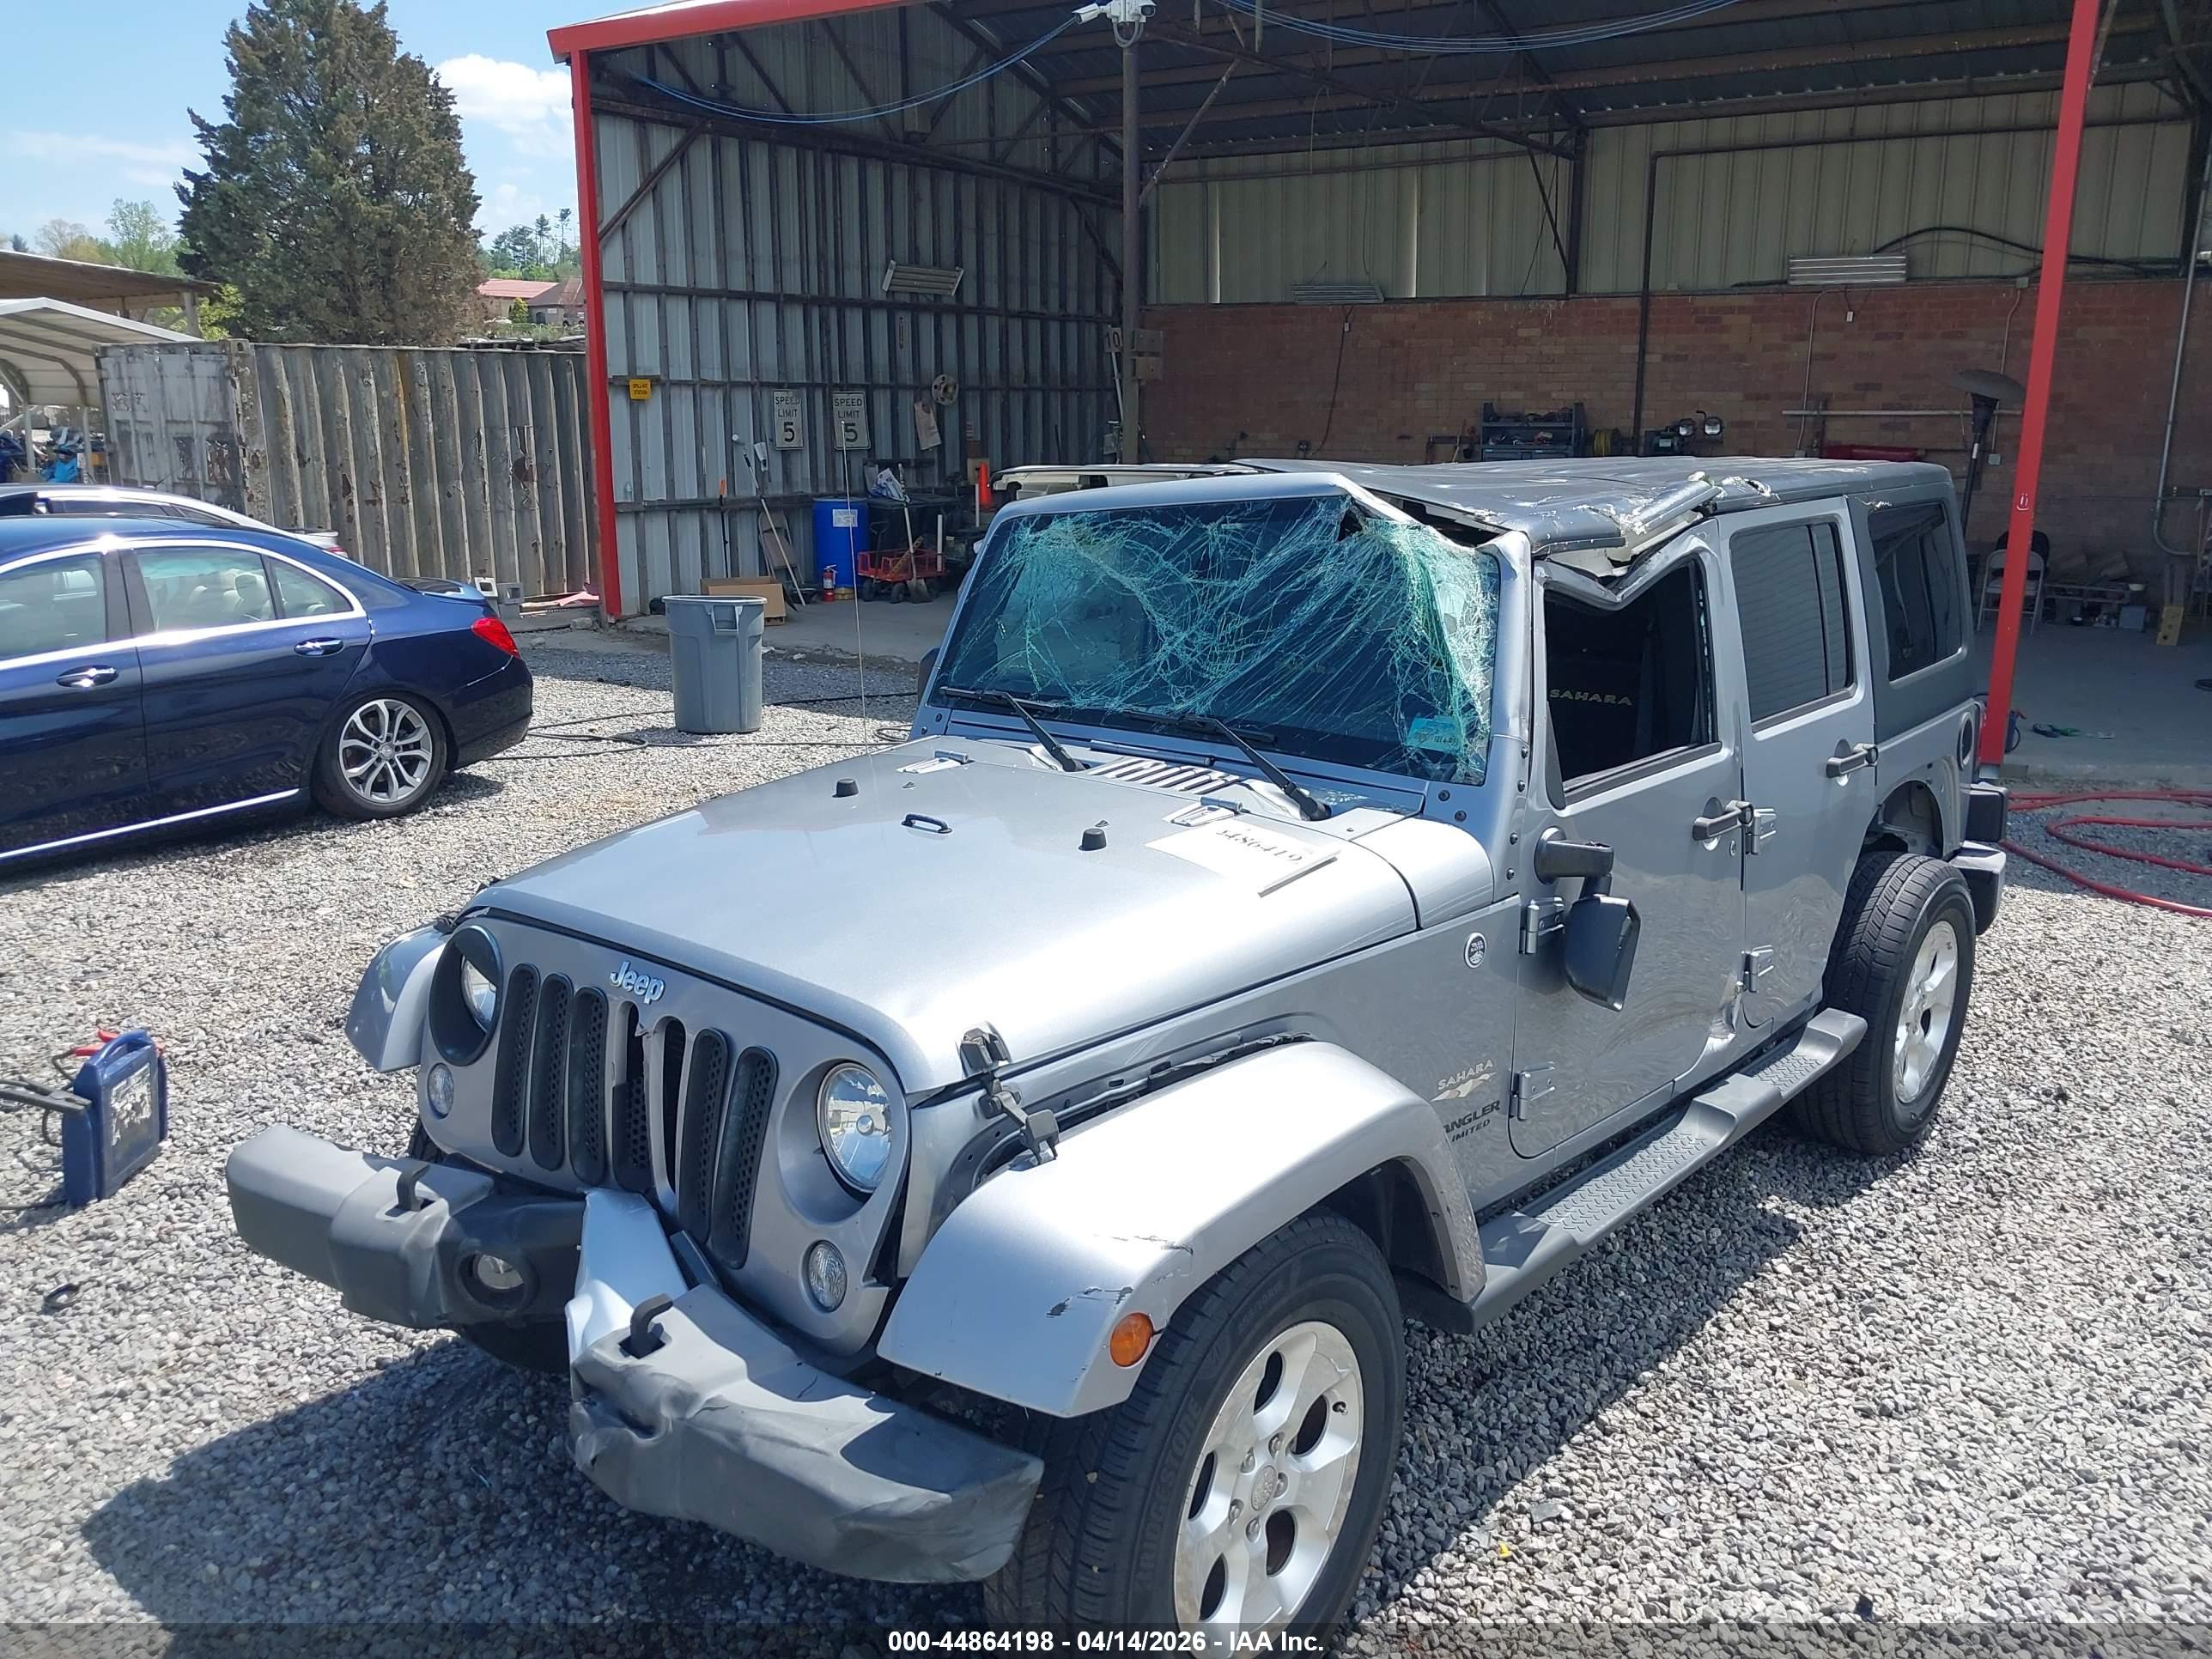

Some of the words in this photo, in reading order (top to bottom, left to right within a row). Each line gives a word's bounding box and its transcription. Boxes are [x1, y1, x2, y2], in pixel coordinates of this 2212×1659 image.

[1105, 331, 1121, 348] 10
[775, 396, 800, 404] SPEED
[834, 398, 863, 407] SPEED
[777, 409, 798, 418] LIMIT
[838, 410, 860, 419] LIMIT
[783, 422, 795, 442] 5
[844, 422, 859, 443] 5
[1549, 689, 1632, 706] SAHARA
[610, 961, 665, 1004] Jeep
[1438, 1059, 1493, 1091] SAHARA
[1443, 1100, 1500, 1133] ANGLER
[1451, 1119, 1491, 1143] IMITED
